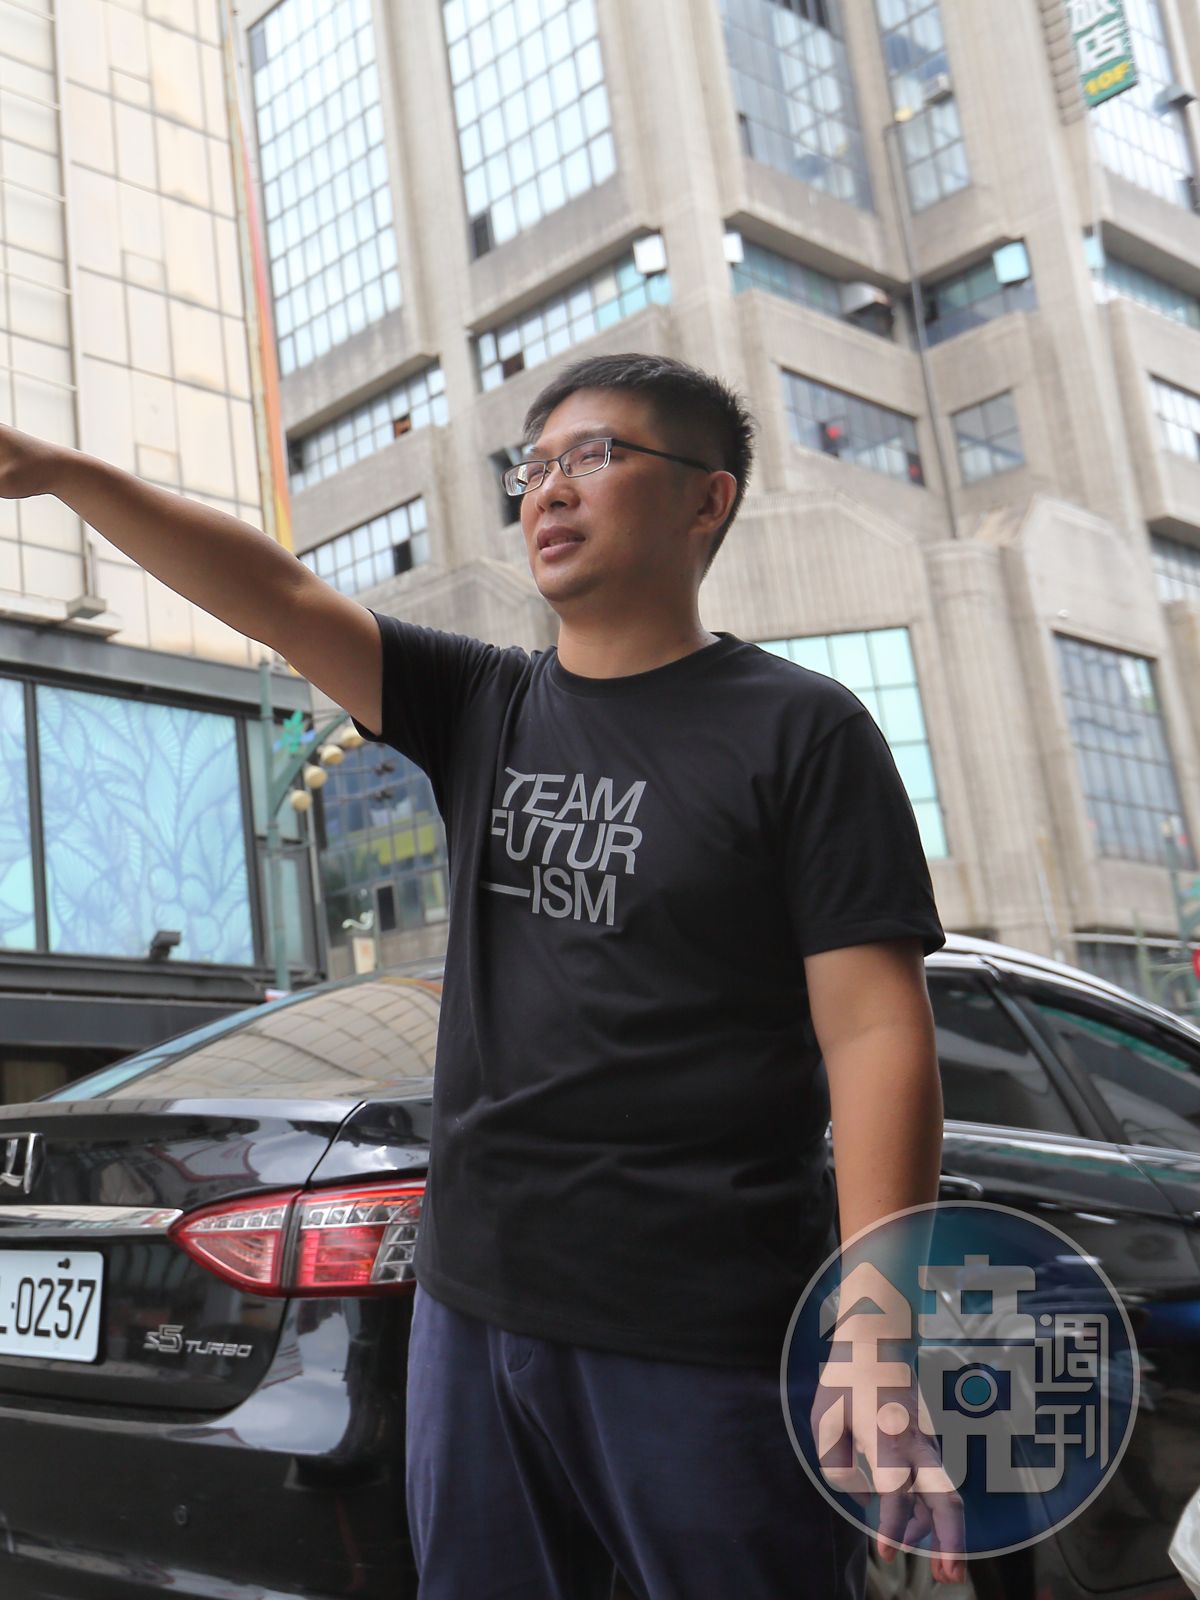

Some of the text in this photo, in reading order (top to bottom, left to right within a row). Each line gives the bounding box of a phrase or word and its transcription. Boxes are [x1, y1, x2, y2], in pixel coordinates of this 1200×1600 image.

[502, 766, 647, 823] TEAM
[491, 808, 643, 875] FUTUR
[185, 1339, 254, 1358] TURBO
